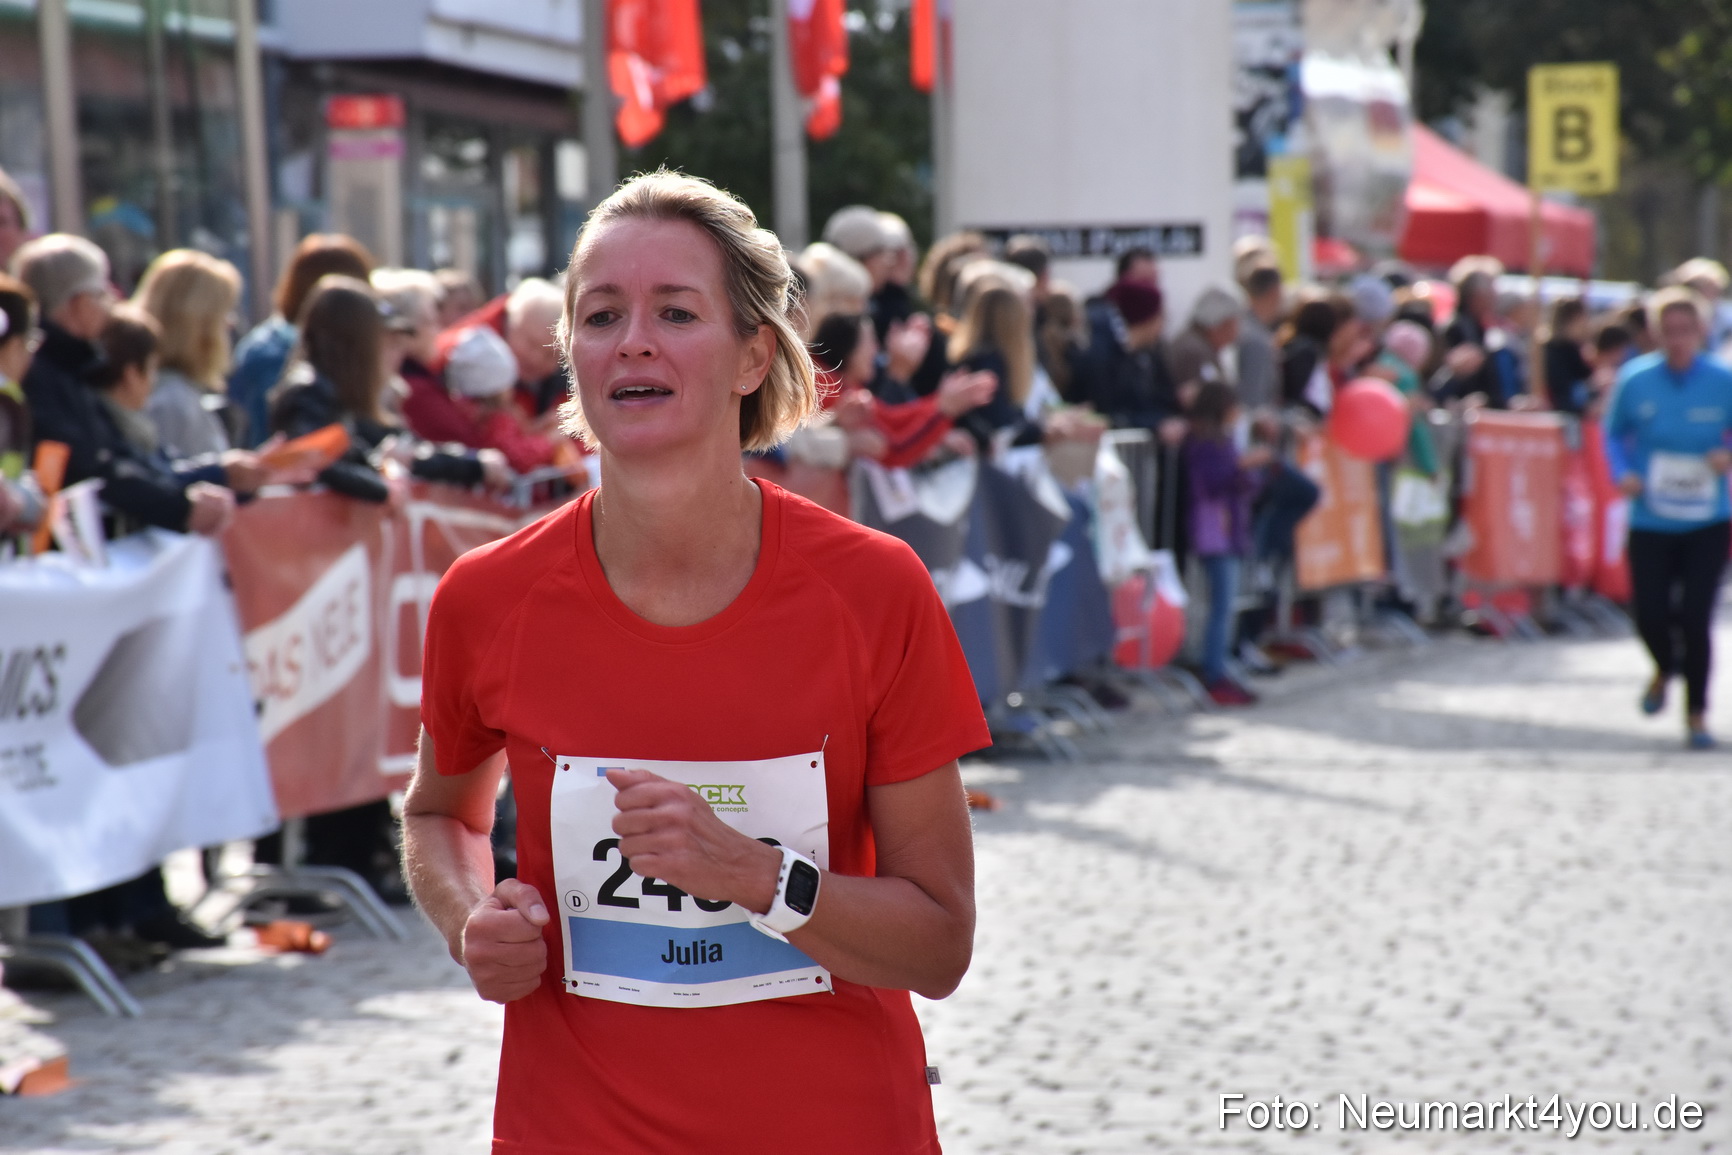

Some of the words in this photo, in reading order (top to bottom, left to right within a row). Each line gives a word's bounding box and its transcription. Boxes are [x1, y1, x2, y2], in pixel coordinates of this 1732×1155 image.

[1553, 104, 1593, 164] B
[686, 784, 747, 805] CK
[716, 806, 749, 814] concepts
[572, 895, 582, 908] D
[660, 938, 724, 966] Julia
